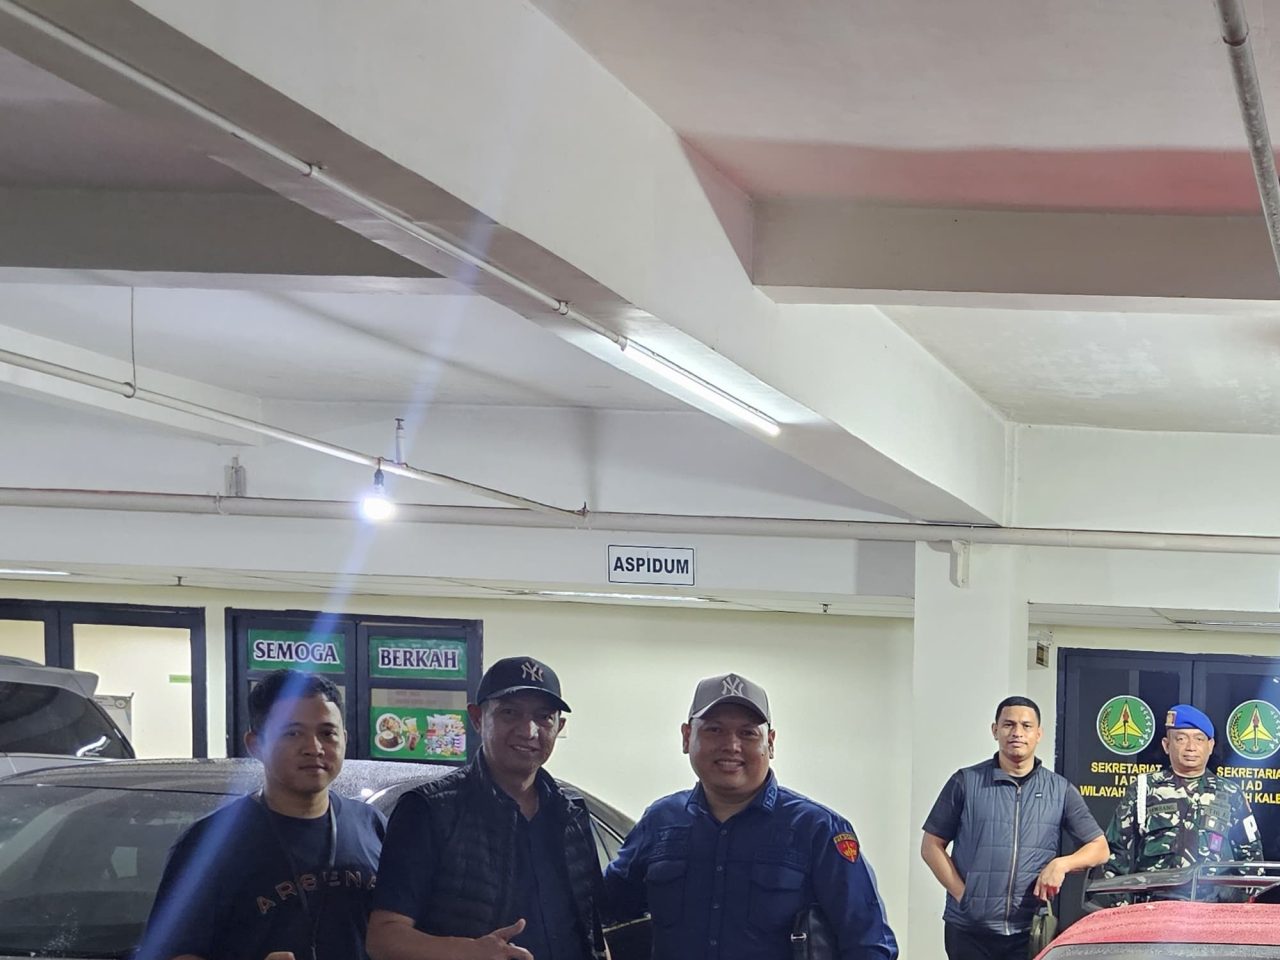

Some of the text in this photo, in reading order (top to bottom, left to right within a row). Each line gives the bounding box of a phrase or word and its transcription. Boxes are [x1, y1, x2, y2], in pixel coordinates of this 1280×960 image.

[613, 556, 689, 575] ASPIDUM
[254, 640, 459, 669] SEMOGA BERKAH
[1091, 762, 1163, 774] SEKRETARIAT
[1080, 785, 1126, 797] WILAYAH
[1241, 780, 1263, 791] IAD
